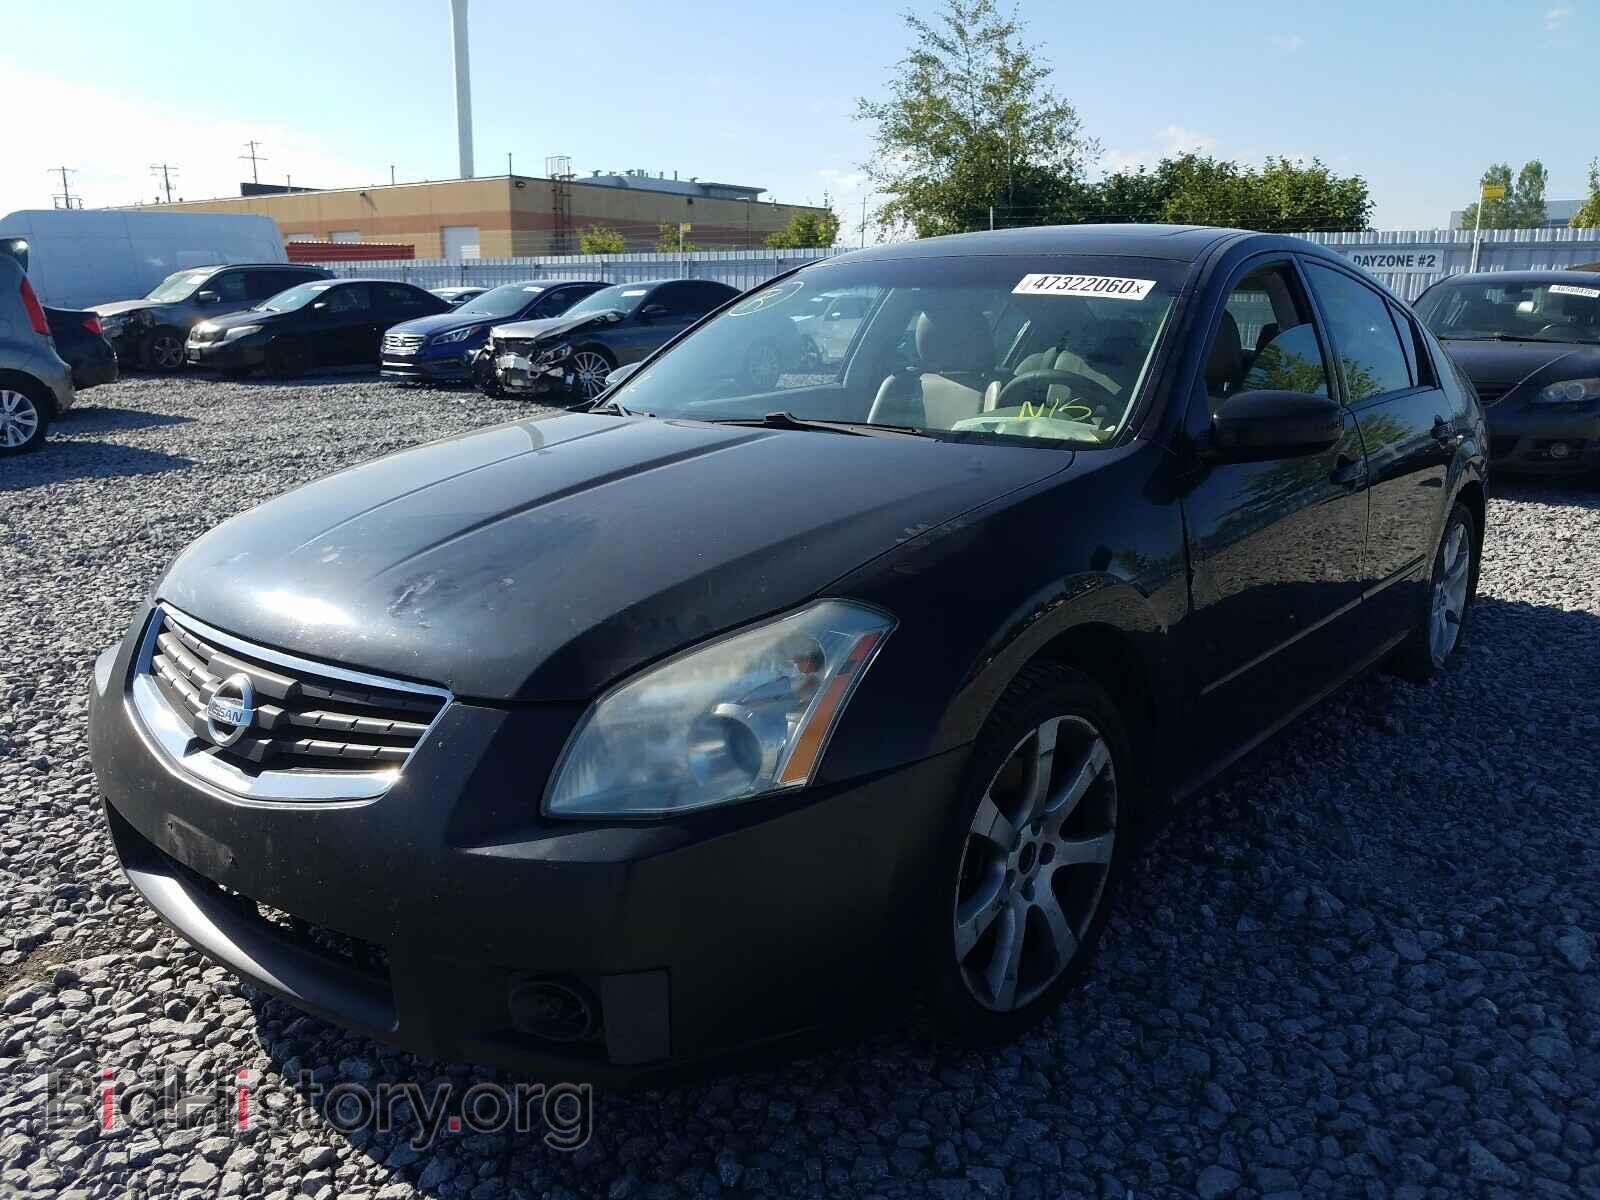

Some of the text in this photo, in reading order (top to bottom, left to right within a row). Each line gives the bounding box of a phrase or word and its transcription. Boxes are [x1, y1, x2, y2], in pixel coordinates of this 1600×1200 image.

[1353, 254, 1436, 268] DAYZONE #2
[208, 701, 243, 723] NISSAN
